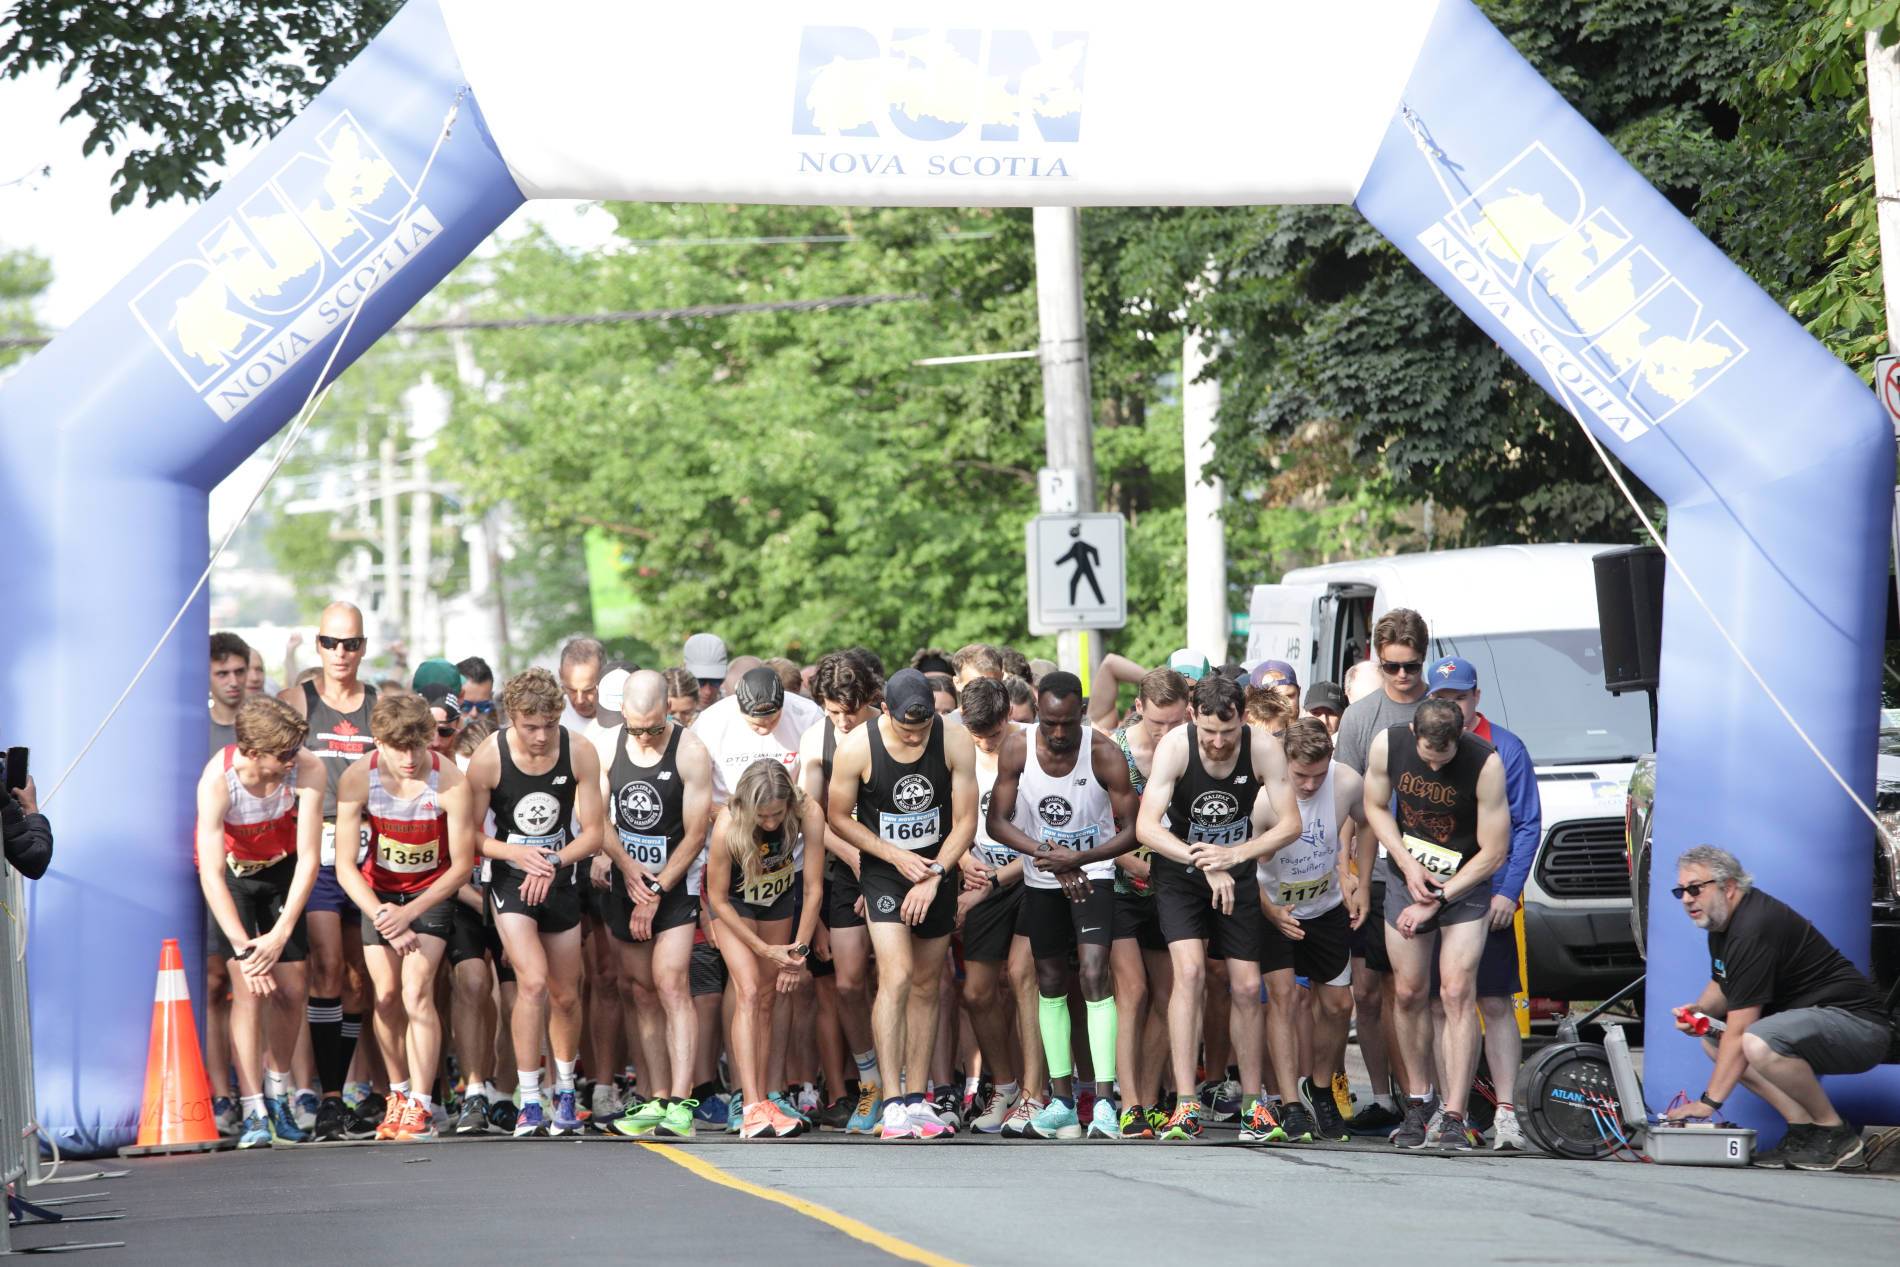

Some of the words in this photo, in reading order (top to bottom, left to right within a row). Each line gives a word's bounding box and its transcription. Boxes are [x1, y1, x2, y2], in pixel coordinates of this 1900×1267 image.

[791, 25, 1090, 143] RUN
[797, 151, 907, 176] NOVA
[927, 154, 1071, 178] SCOTIA
[128, 108, 418, 393] RUN
[1443, 140, 1750, 426] RUN
[218, 329, 315, 412] NOVA
[317, 220, 435, 325] SCOTIA
[1430, 236, 1511, 319] NOVA
[1521, 327, 1635, 434] SCOTIA
[328, 740, 364, 753] FORCES
[628, 784, 653, 796] HALIFAX
[1202, 793, 1231, 802] HALIFAX
[885, 818, 937, 840] 1664
[382, 847, 434, 865] 1358
[749, 874, 792, 901] 1201
[1282, 879, 1329, 901] 1172
[1729, 1140, 1739, 1156] 6
